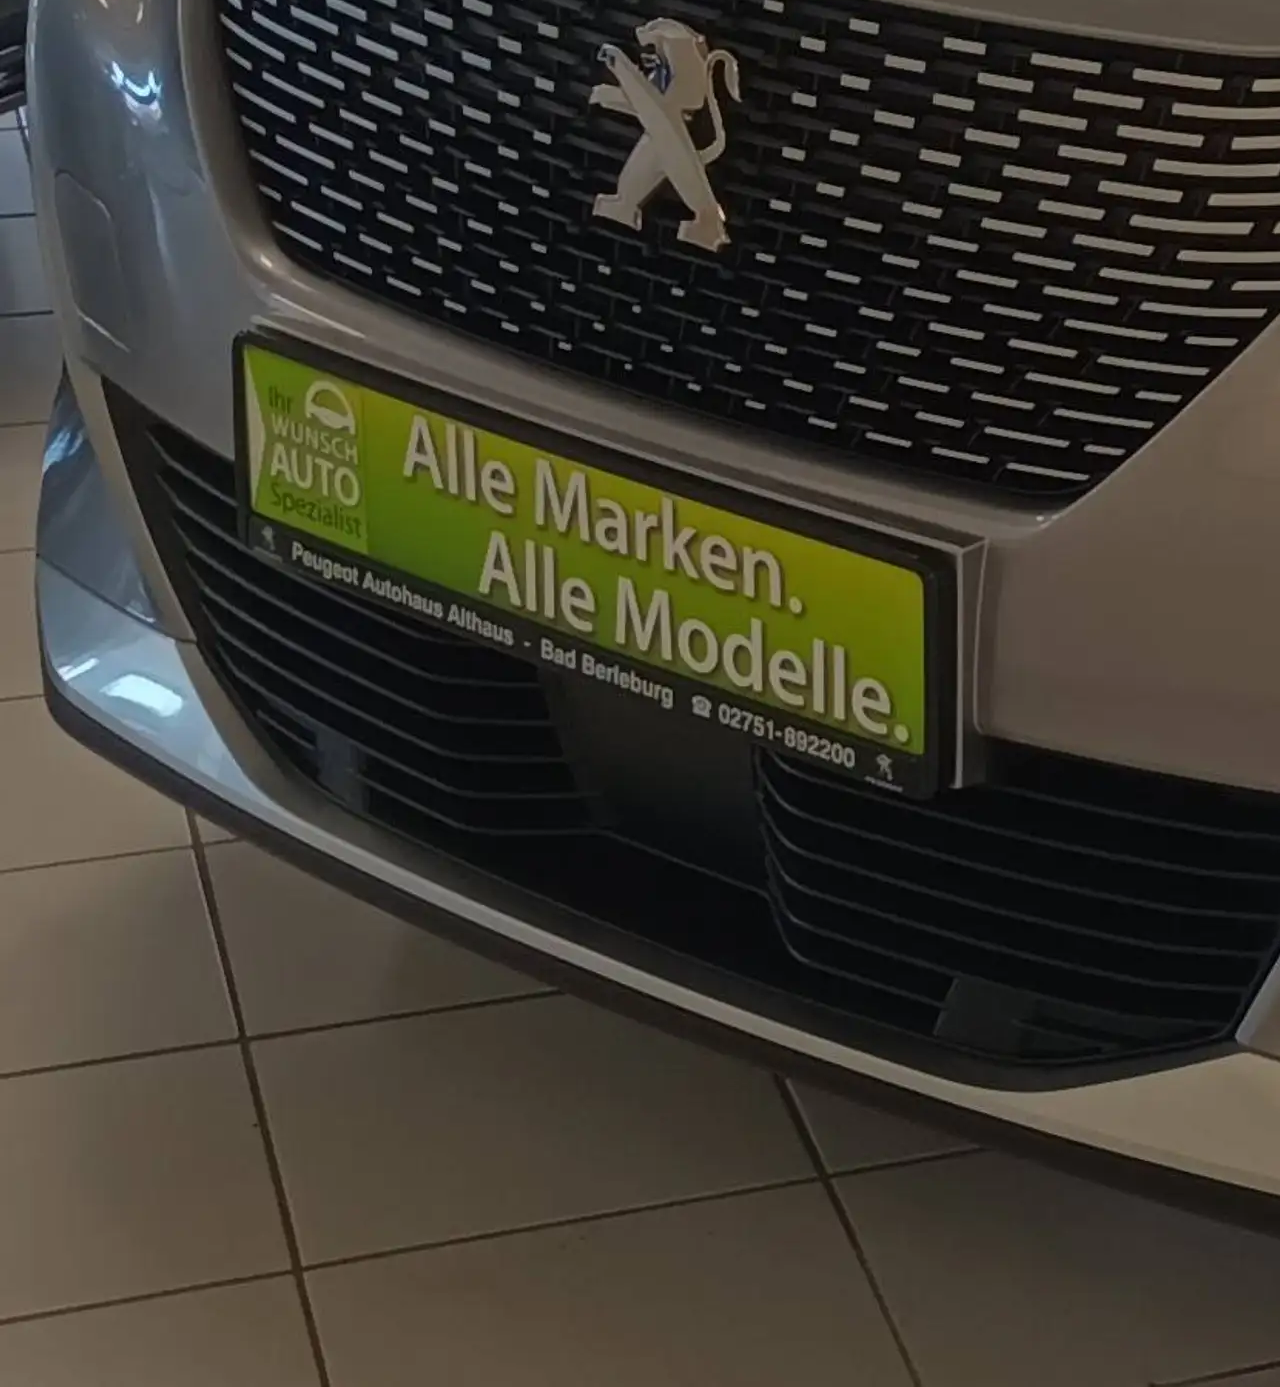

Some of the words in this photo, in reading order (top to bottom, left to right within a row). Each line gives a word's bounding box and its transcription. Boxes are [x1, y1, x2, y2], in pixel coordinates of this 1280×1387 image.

[268, 385, 293, 413] Ihr
[272, 414, 358, 464] WUNSCH
[270, 442, 361, 506] AUTO
[271, 482, 362, 538] Spezialist
[403, 415, 514, 514] Alle
[535, 460, 804, 614] Marken.
[291, 541, 359, 585] Peugeot
[362, 573, 444, 619] Autohaus
[447, 604, 514, 647] Althaus
[541, 638, 577, 670] Bad
[582, 653, 674, 709] Berleburg
[478, 531, 595, 632] Alle
[615, 575, 909, 743] Modelle.
